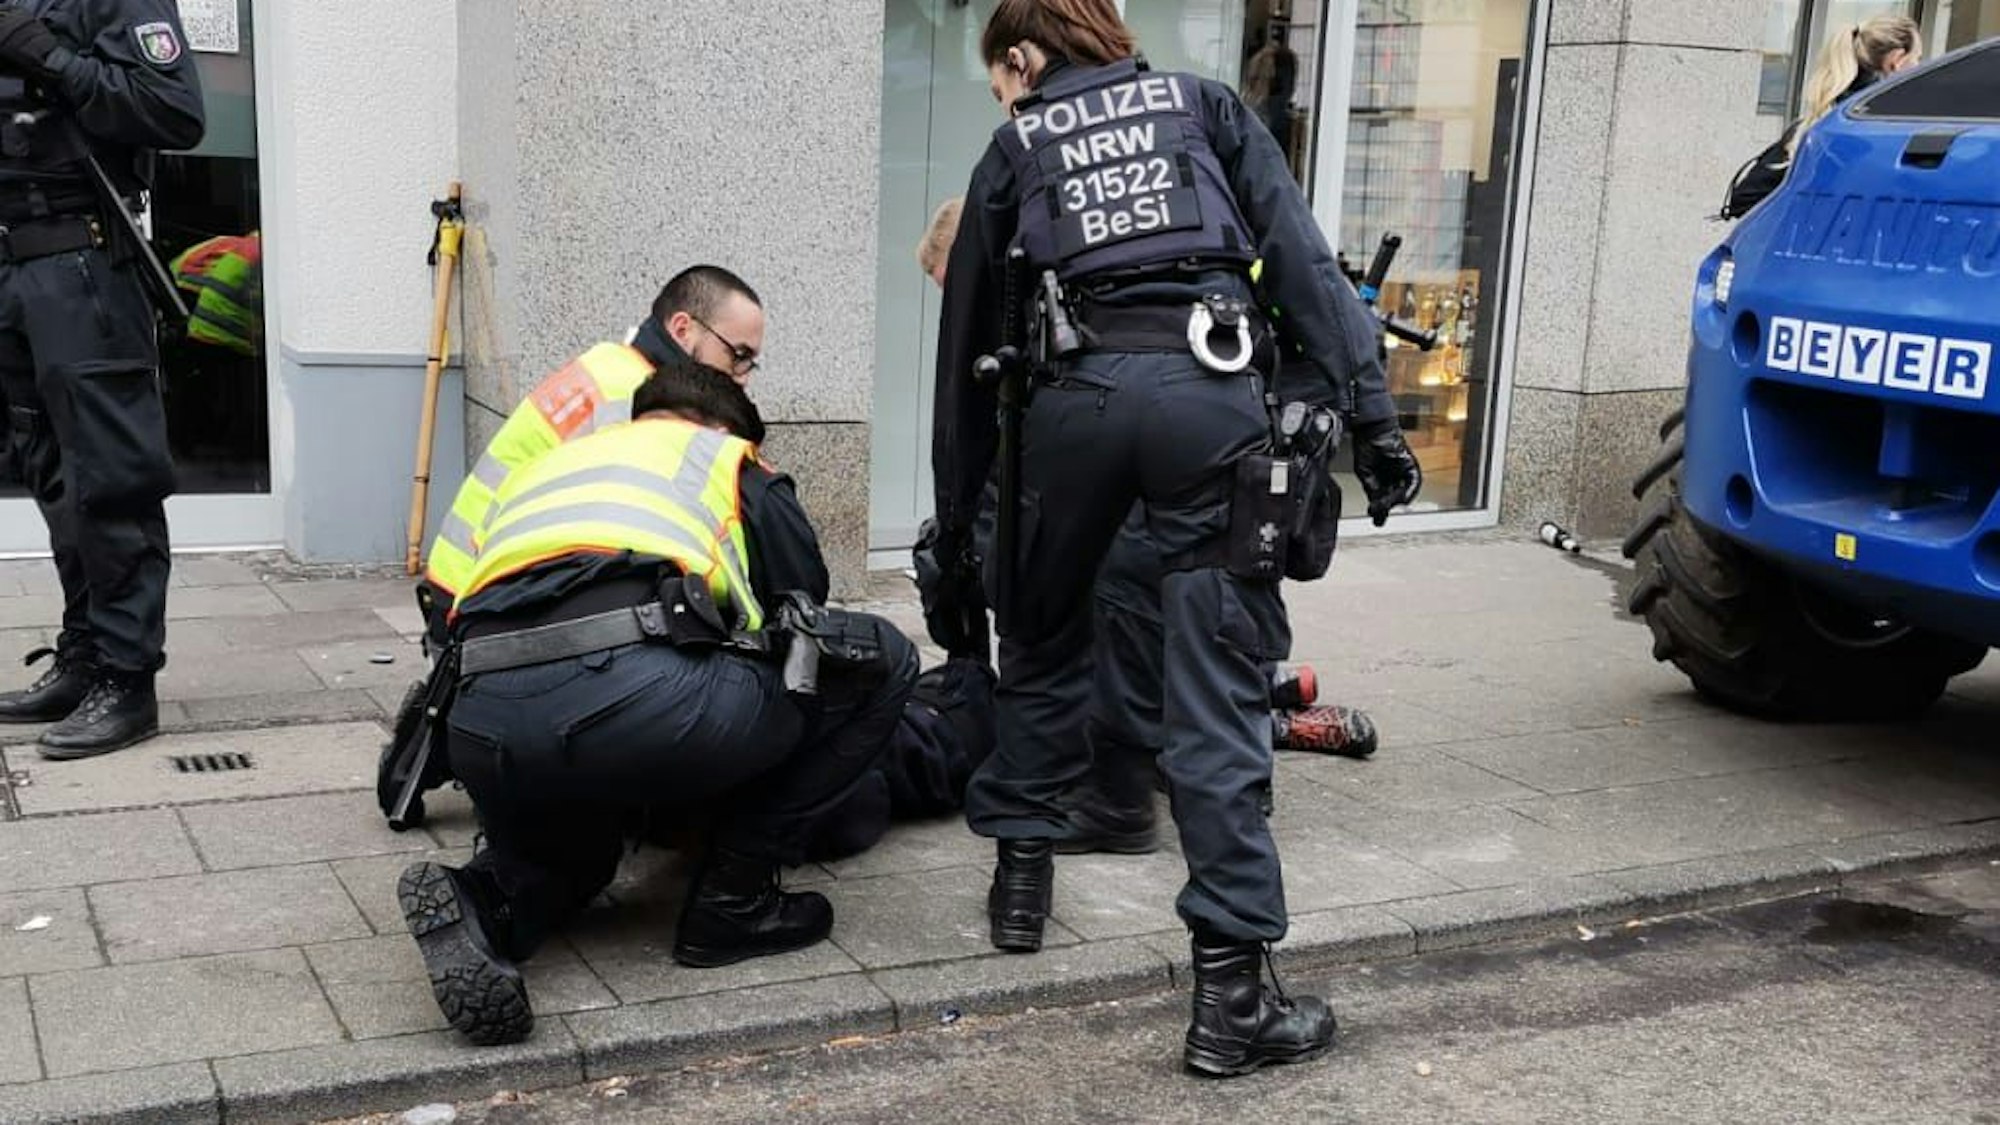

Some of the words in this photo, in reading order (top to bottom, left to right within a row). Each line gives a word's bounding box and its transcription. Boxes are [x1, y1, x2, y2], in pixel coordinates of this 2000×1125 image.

[1015, 77, 1184, 150] POLIZEI
[1060, 122, 1155, 171] NRW
[1063, 157, 1173, 212] 31522
[1081, 194, 1171, 245] BeSi
[1773, 325, 1979, 389] BEYER
